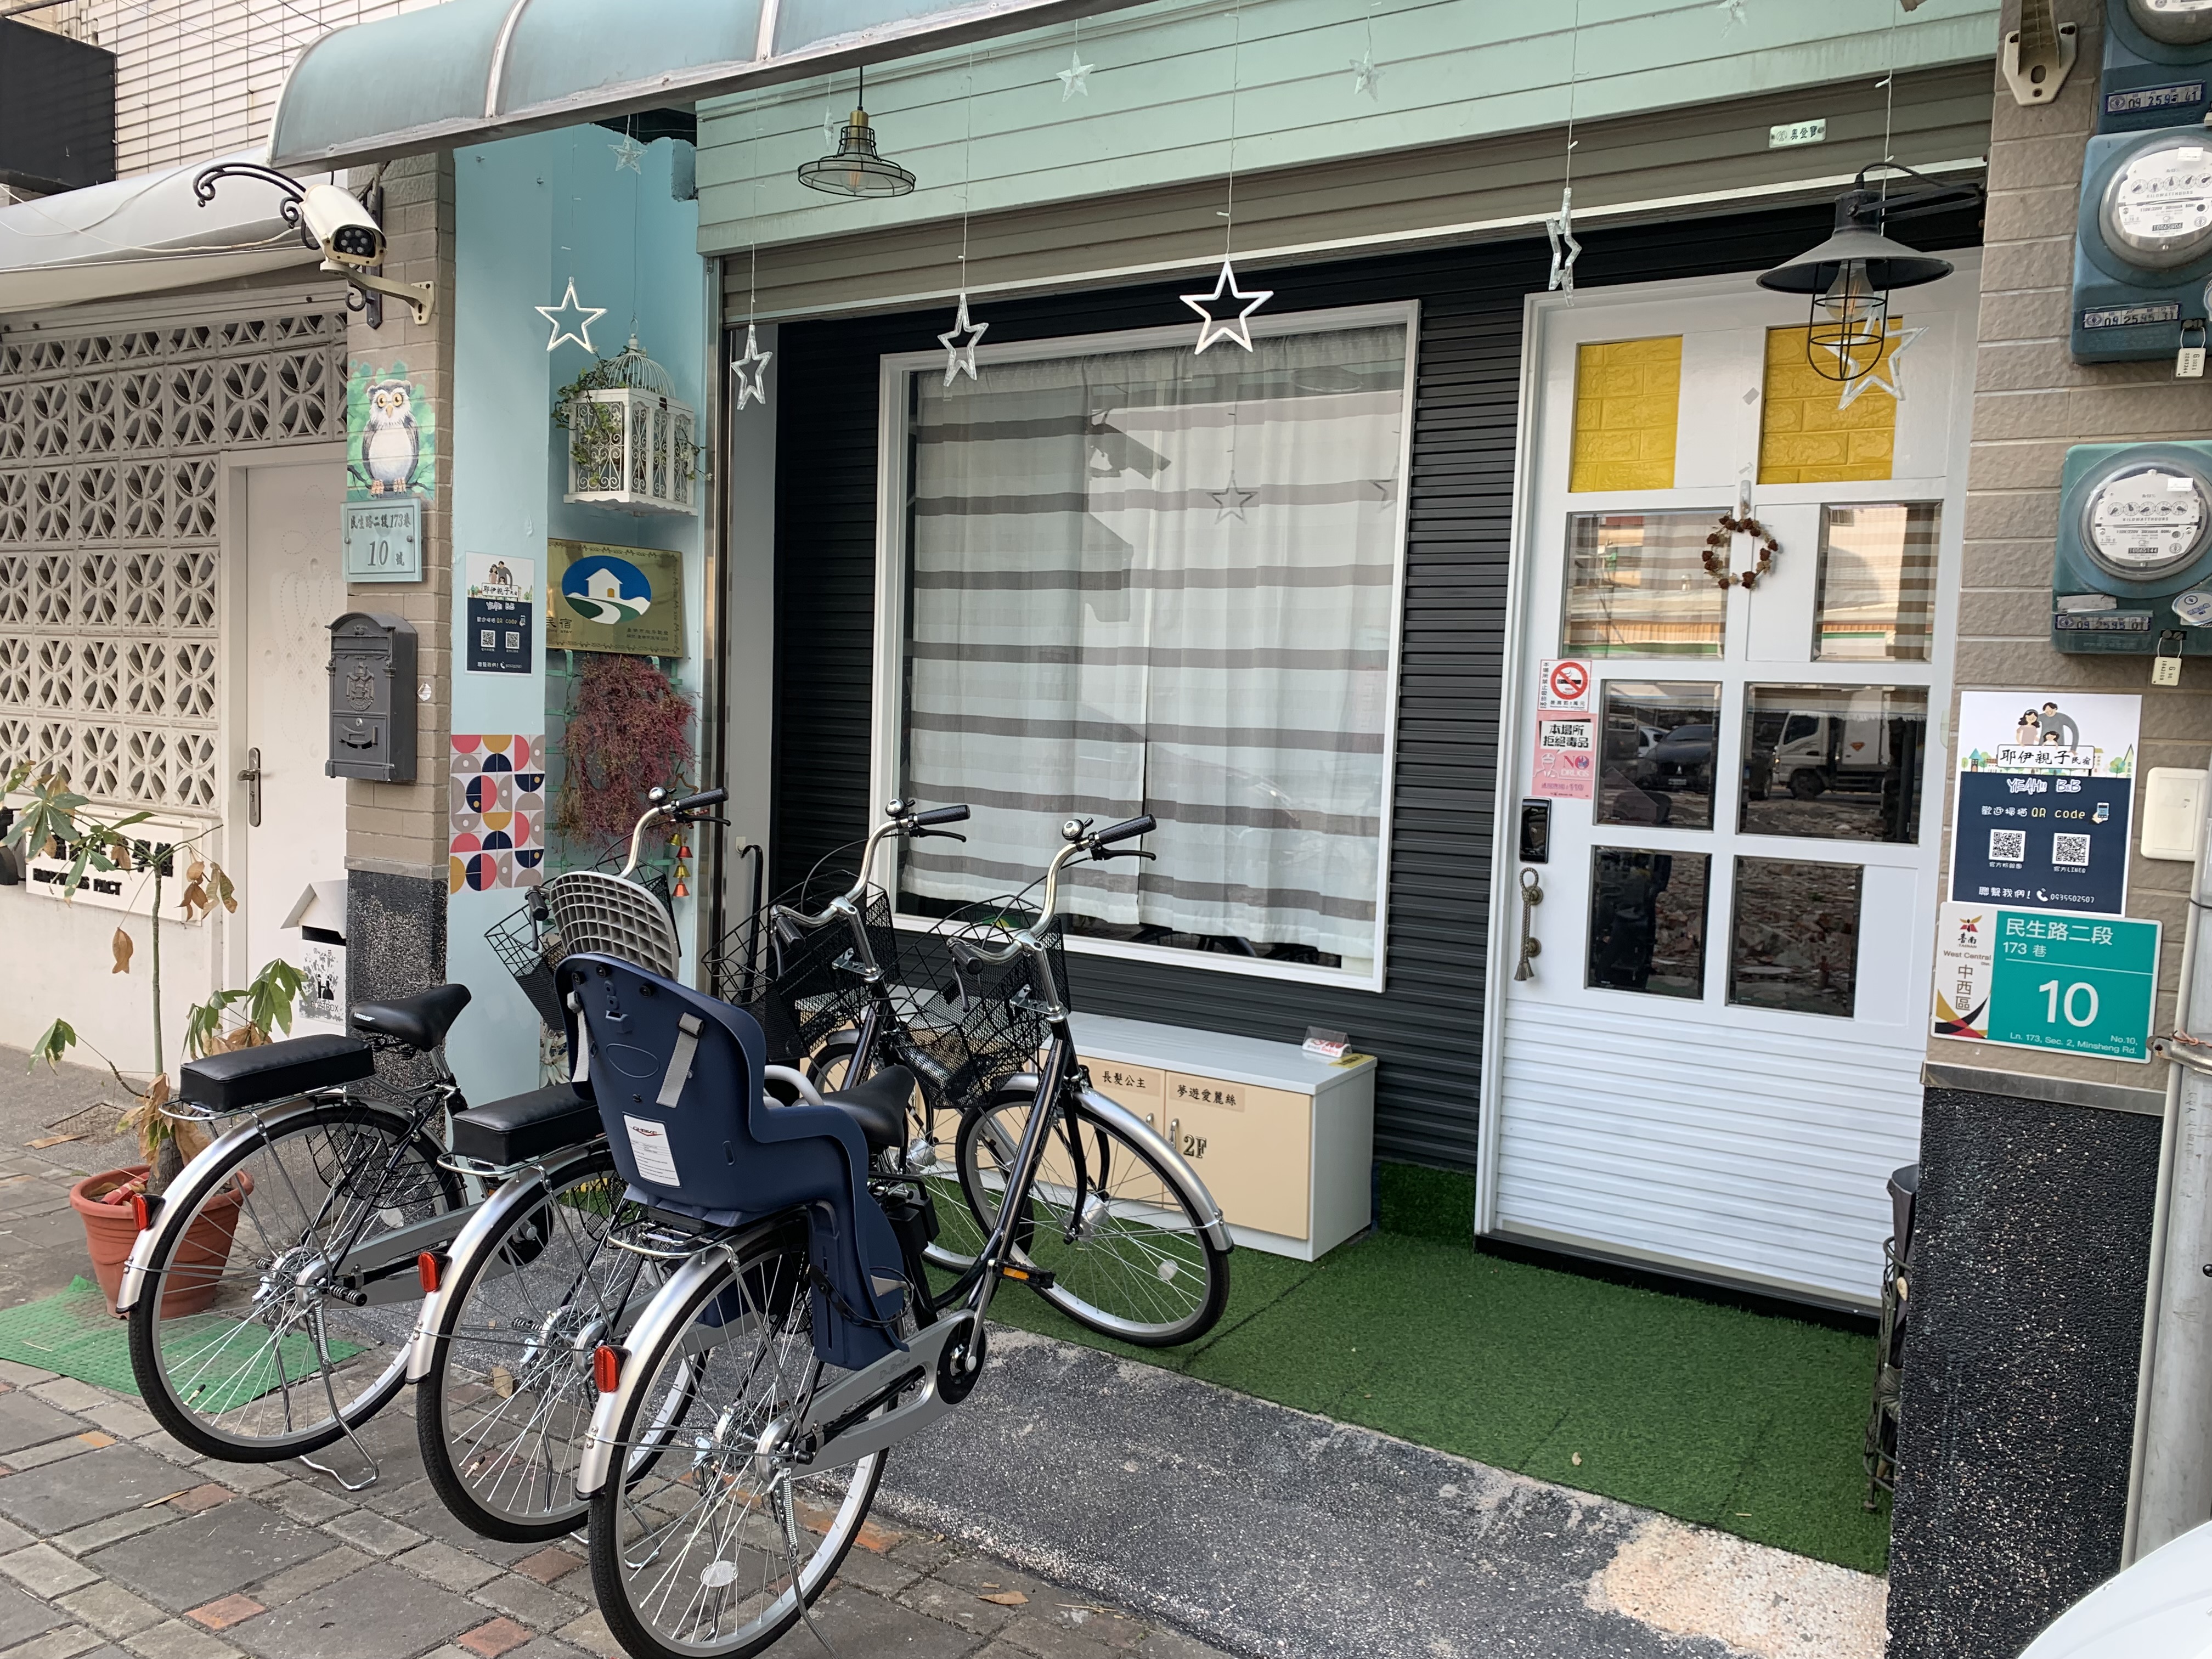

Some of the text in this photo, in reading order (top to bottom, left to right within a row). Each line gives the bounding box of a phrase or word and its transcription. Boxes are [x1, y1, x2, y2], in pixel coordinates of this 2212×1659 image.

[368, 540, 388, 566] 10
[1549, 724, 1584, 736] 本場所
[1543, 735, 1589, 748] 拒絕毒品
[1561, 769, 1589, 777] DRUGS
[1981, 806, 2085, 819] 歡迎掃描 QR code
[2006, 918, 2113, 946] 民生路二段
[1963, 952, 1991, 961] Central
[2003, 941, 2047, 958] 173 巷
[1955, 964, 1973, 1011] 中西區
[310, 1001, 339, 1012] POSTBOX
[2039, 979, 2100, 1028] 10
[2010, 1032, 2137, 1054] Ln. 173, Sec. 2, Minsheng Rd.
[2111, 1035, 2138, 1046] No.10,
[1102, 1070, 1147, 1088] 長髮公主
[1177, 1084, 1237, 1106] 夢遊愛麗絲
[1183, 1134, 1207, 1159] 2F
